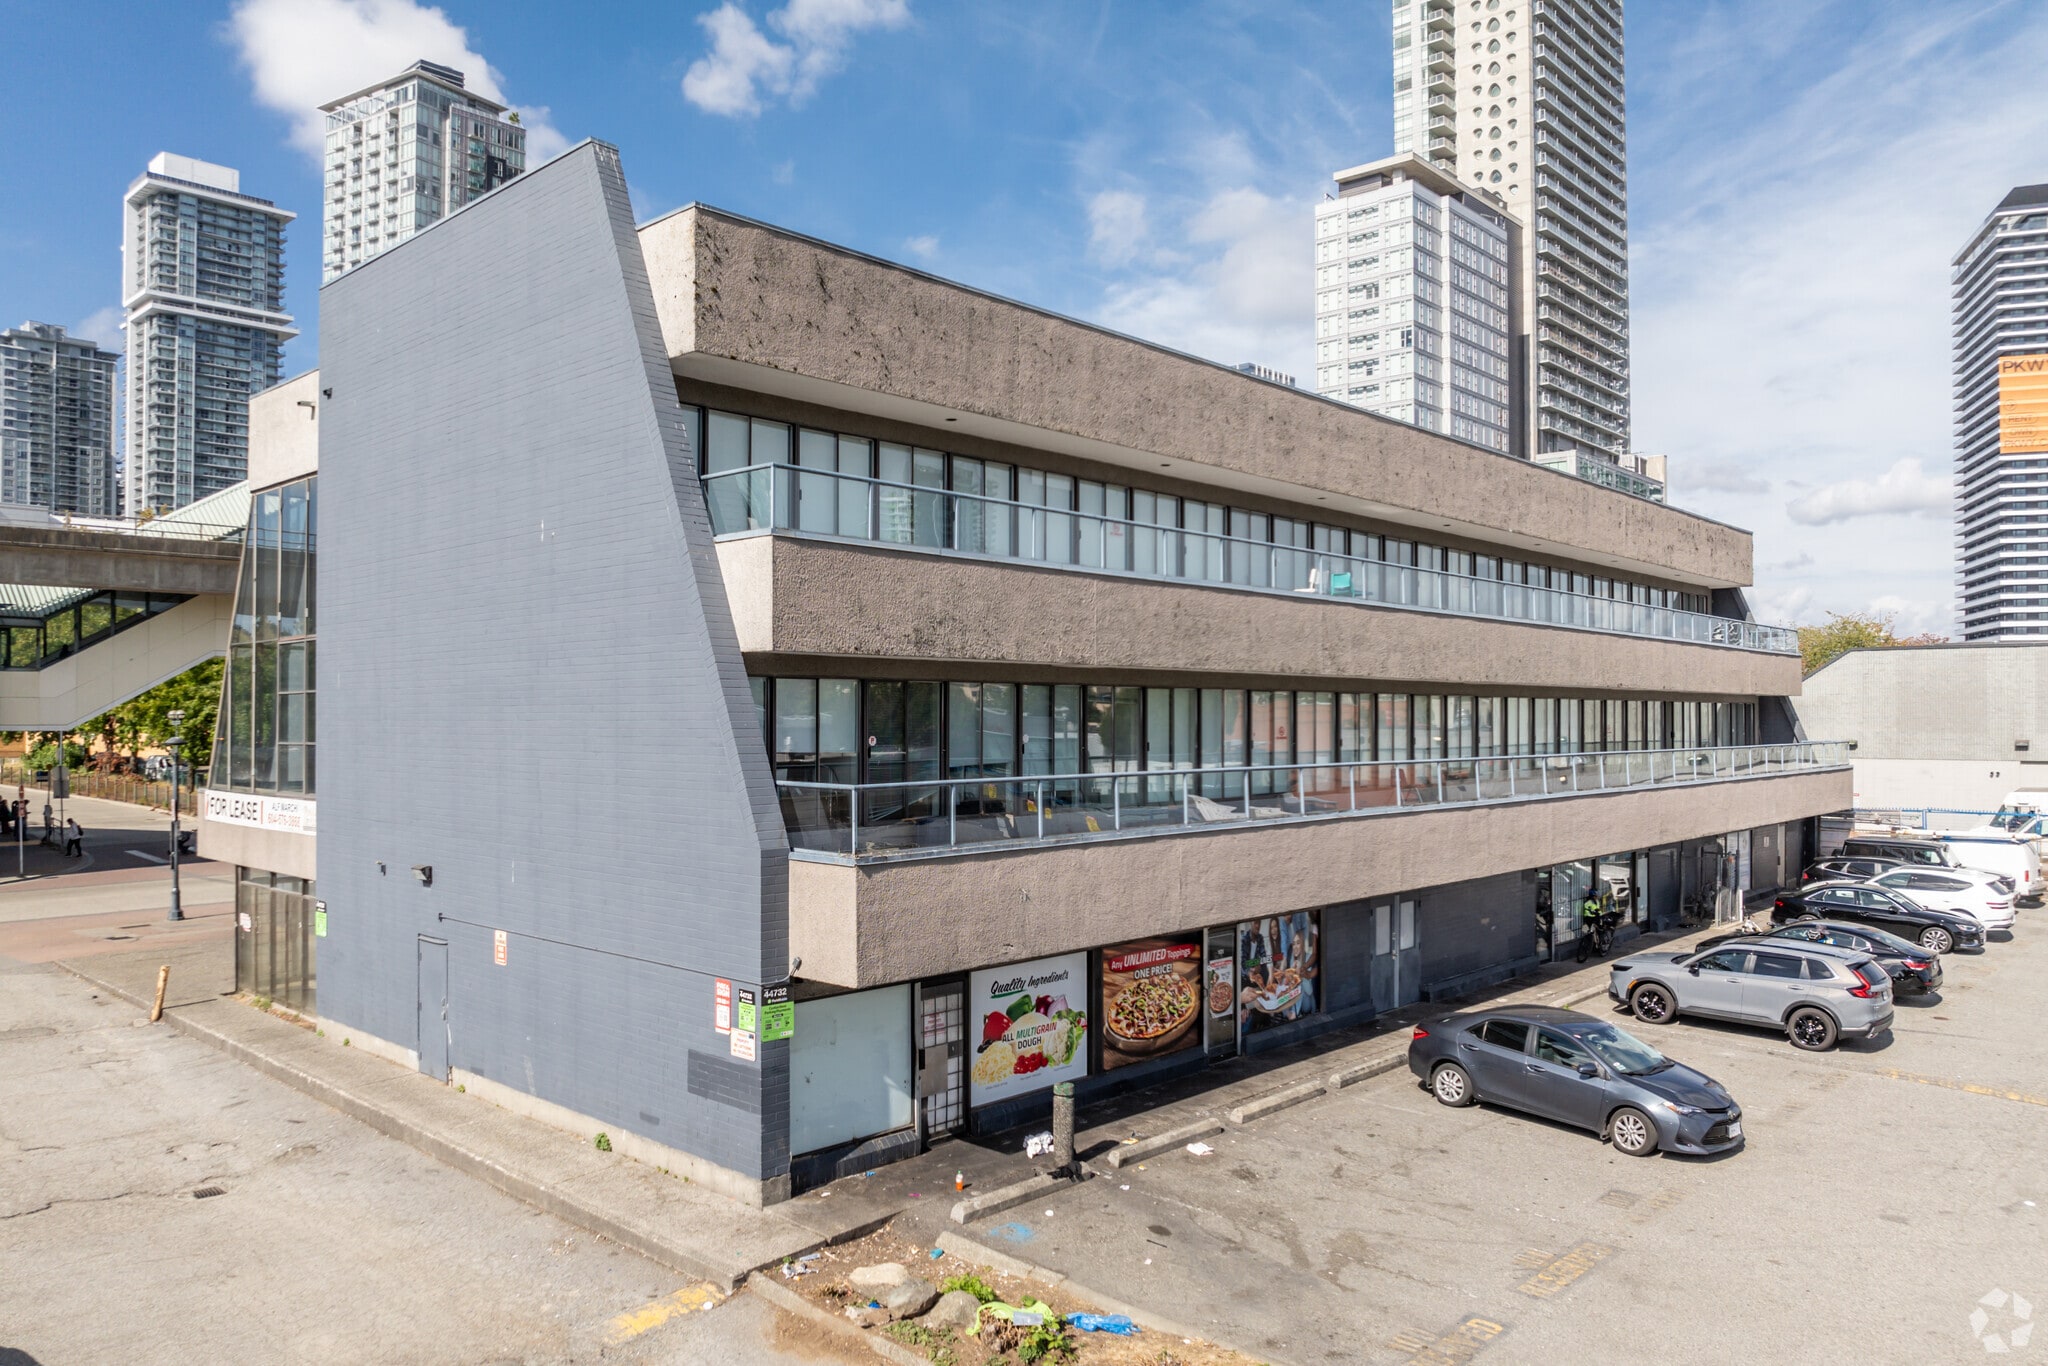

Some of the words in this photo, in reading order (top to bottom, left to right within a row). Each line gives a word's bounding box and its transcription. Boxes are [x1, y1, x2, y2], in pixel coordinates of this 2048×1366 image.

[2003, 360, 2048, 373] PKW
[210, 797, 228, 816] FOR
[229, 799, 258, 821] LEASE
[1111, 960, 1123, 970] Any
[1123, 949, 1167, 967] UNLIMITED
[1167, 948, 1191, 959] Toppings
[1134, 968, 1150, 979] ONE
[1151, 963, 1173, 975] PRICE!
[990, 976, 1027, 994] Quality
[1027, 969, 1069, 988] Ingredients
[763, 987, 788, 998] 44732
[1002, 1032, 1014, 1042] ALL
[1016, 1022, 1057, 1039] MULTIGRAIN
[1017, 1036, 1042, 1049] DOUGH
